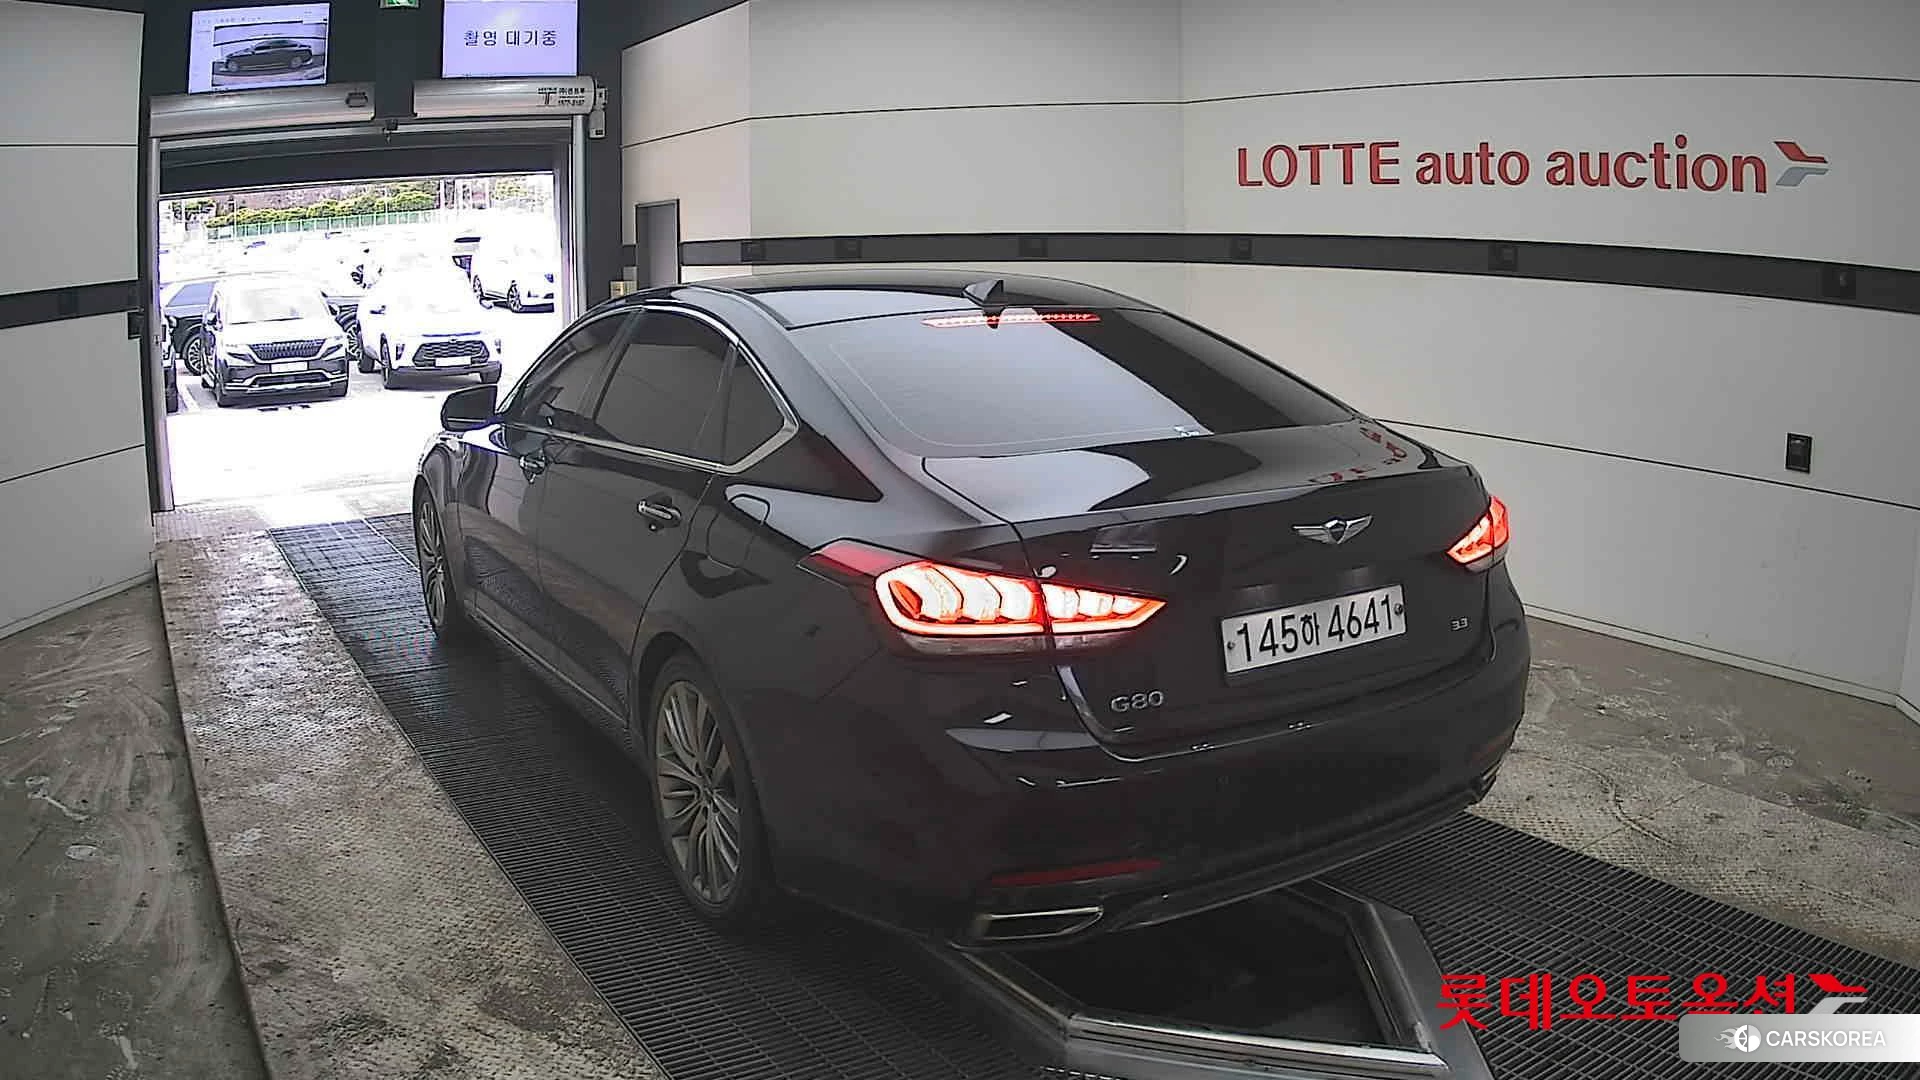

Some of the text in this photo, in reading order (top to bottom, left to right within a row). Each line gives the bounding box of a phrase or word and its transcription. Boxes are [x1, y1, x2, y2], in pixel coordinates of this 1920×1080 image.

[505, 30, 557, 47] 대기중
[1238, 135, 1767, 193] LOTTE auto auction
[1236, 594, 1394, 663] 145하 4641
[1110, 690, 1164, 713] G80
